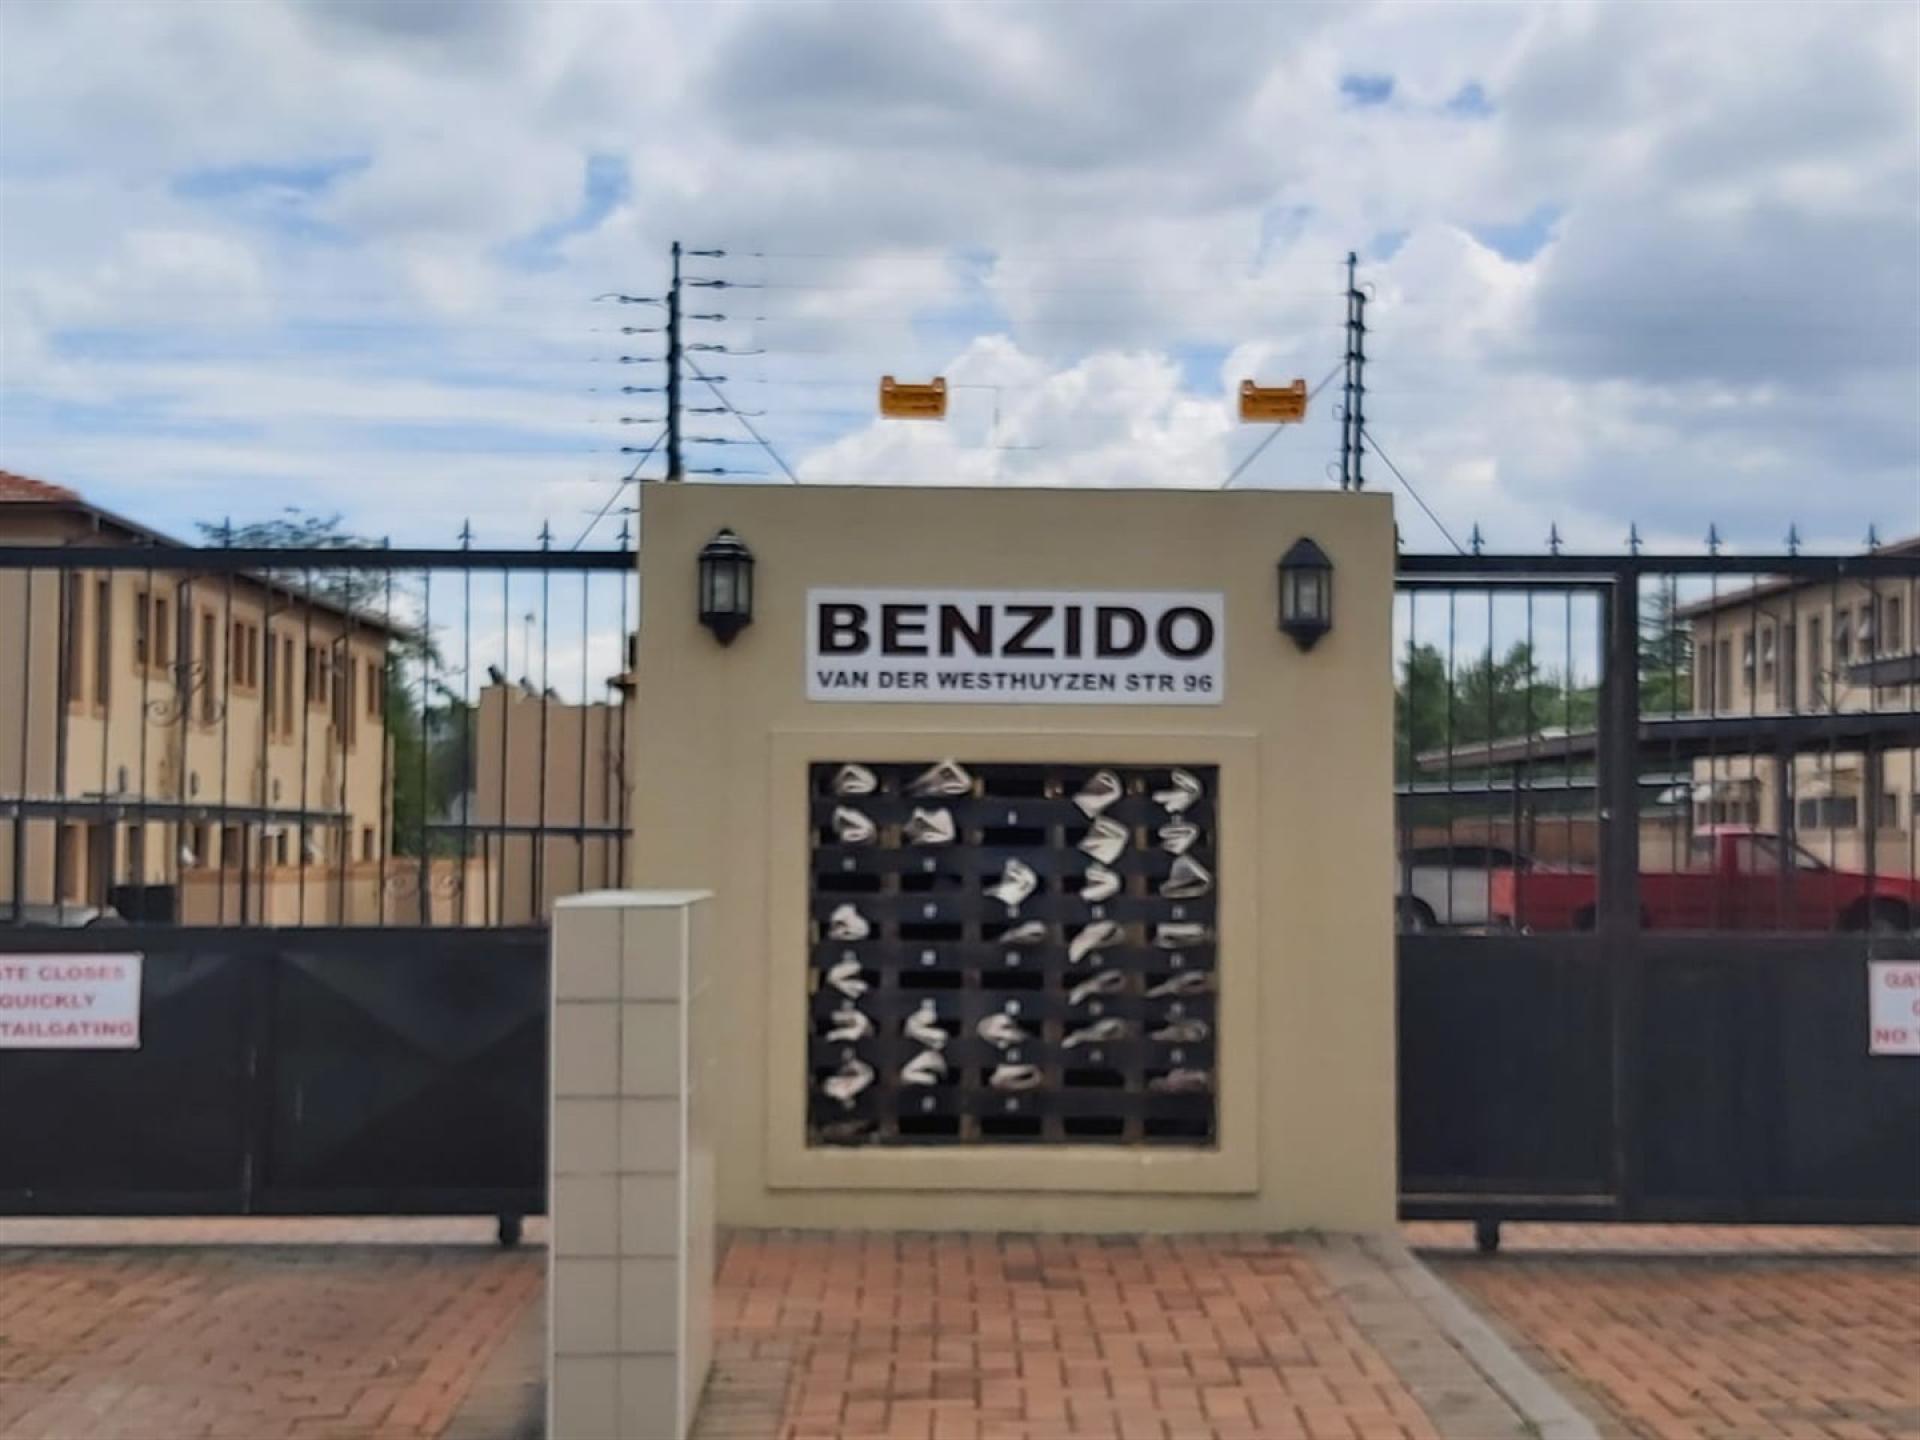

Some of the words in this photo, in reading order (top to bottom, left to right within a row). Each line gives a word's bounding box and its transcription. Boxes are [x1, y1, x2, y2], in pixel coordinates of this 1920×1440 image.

[817, 603, 1215, 660] BENZIDO
[817, 671, 868, 688] VAN
[878, 671, 928, 689] DER
[938, 672, 1115, 691] WESTHUYZEN
[1126, 675, 1175, 692] STR
[1184, 676, 1213, 692] 96
[0, 966, 29, 980] TE
[38, 966, 126, 981] CLOSES
[0, 993, 96, 1009] QUICKLY
[0, 1021, 134, 1037] TAILGATING
